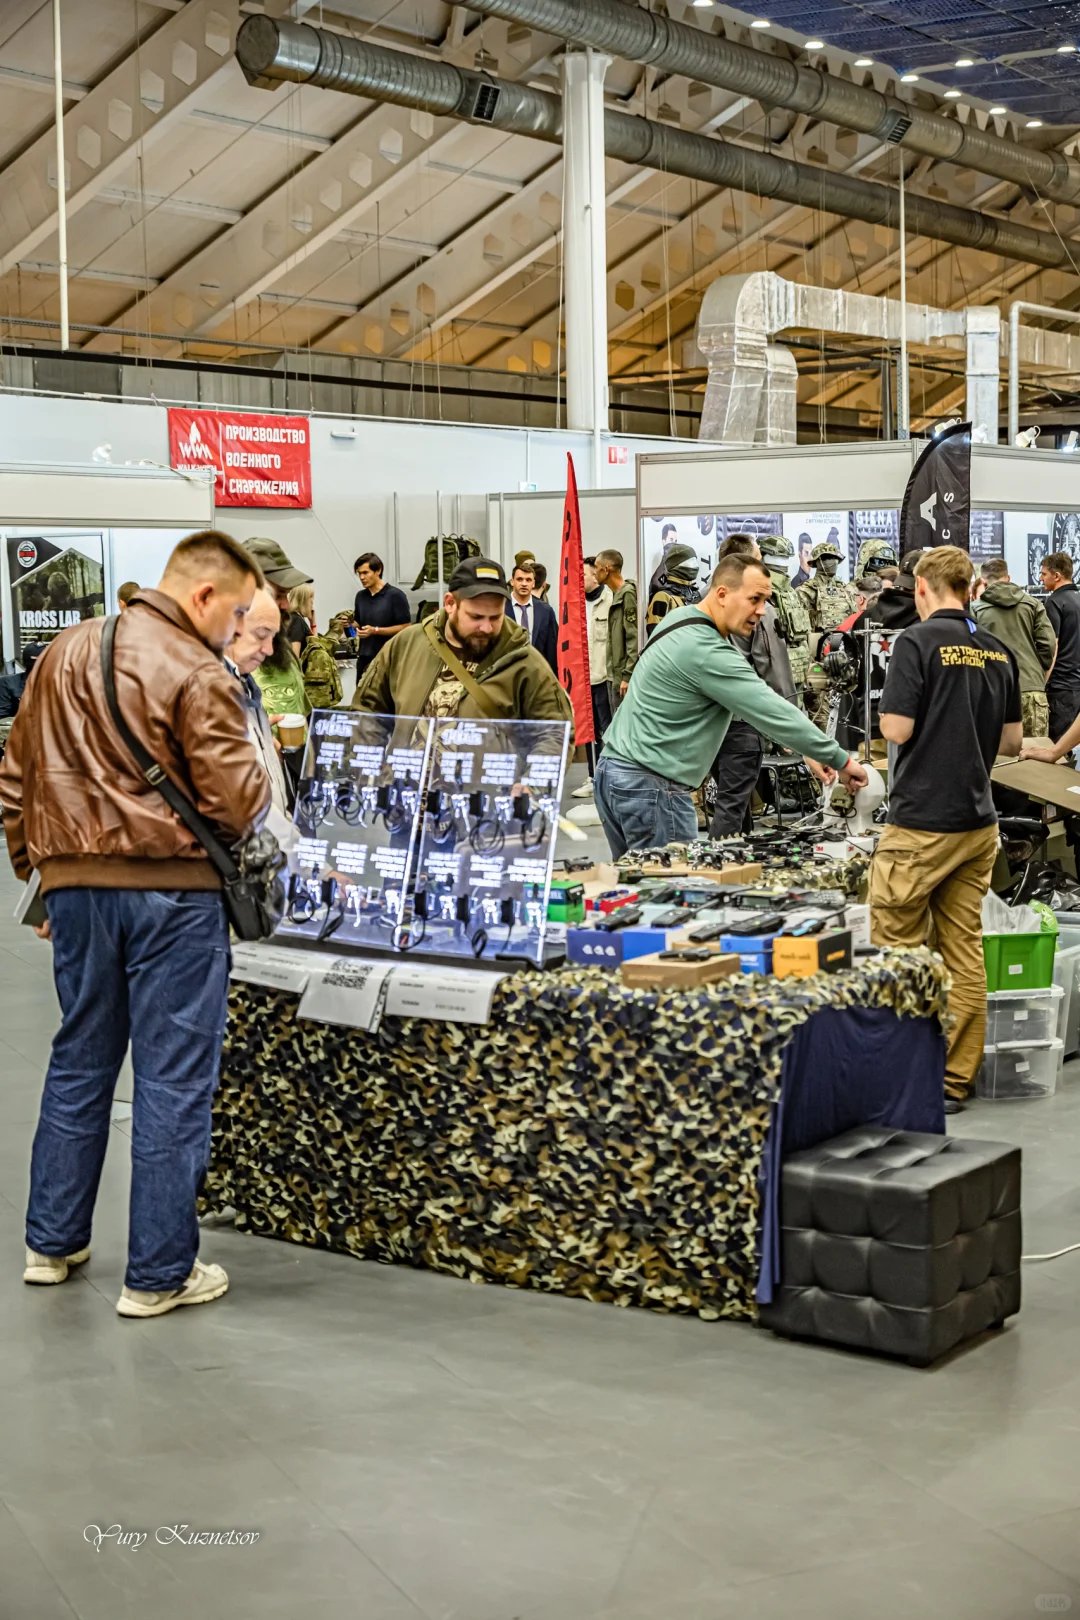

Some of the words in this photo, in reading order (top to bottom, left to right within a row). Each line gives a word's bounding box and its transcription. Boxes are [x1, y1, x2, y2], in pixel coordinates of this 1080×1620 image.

[225, 424, 306, 444] ПРОИЗВОДСТВО
[225, 451, 281, 469] ВОЕННОГО
[228, 478, 300, 496] СНАРЯЖЕНИЯ
[19, 610, 58, 628] KROSS
